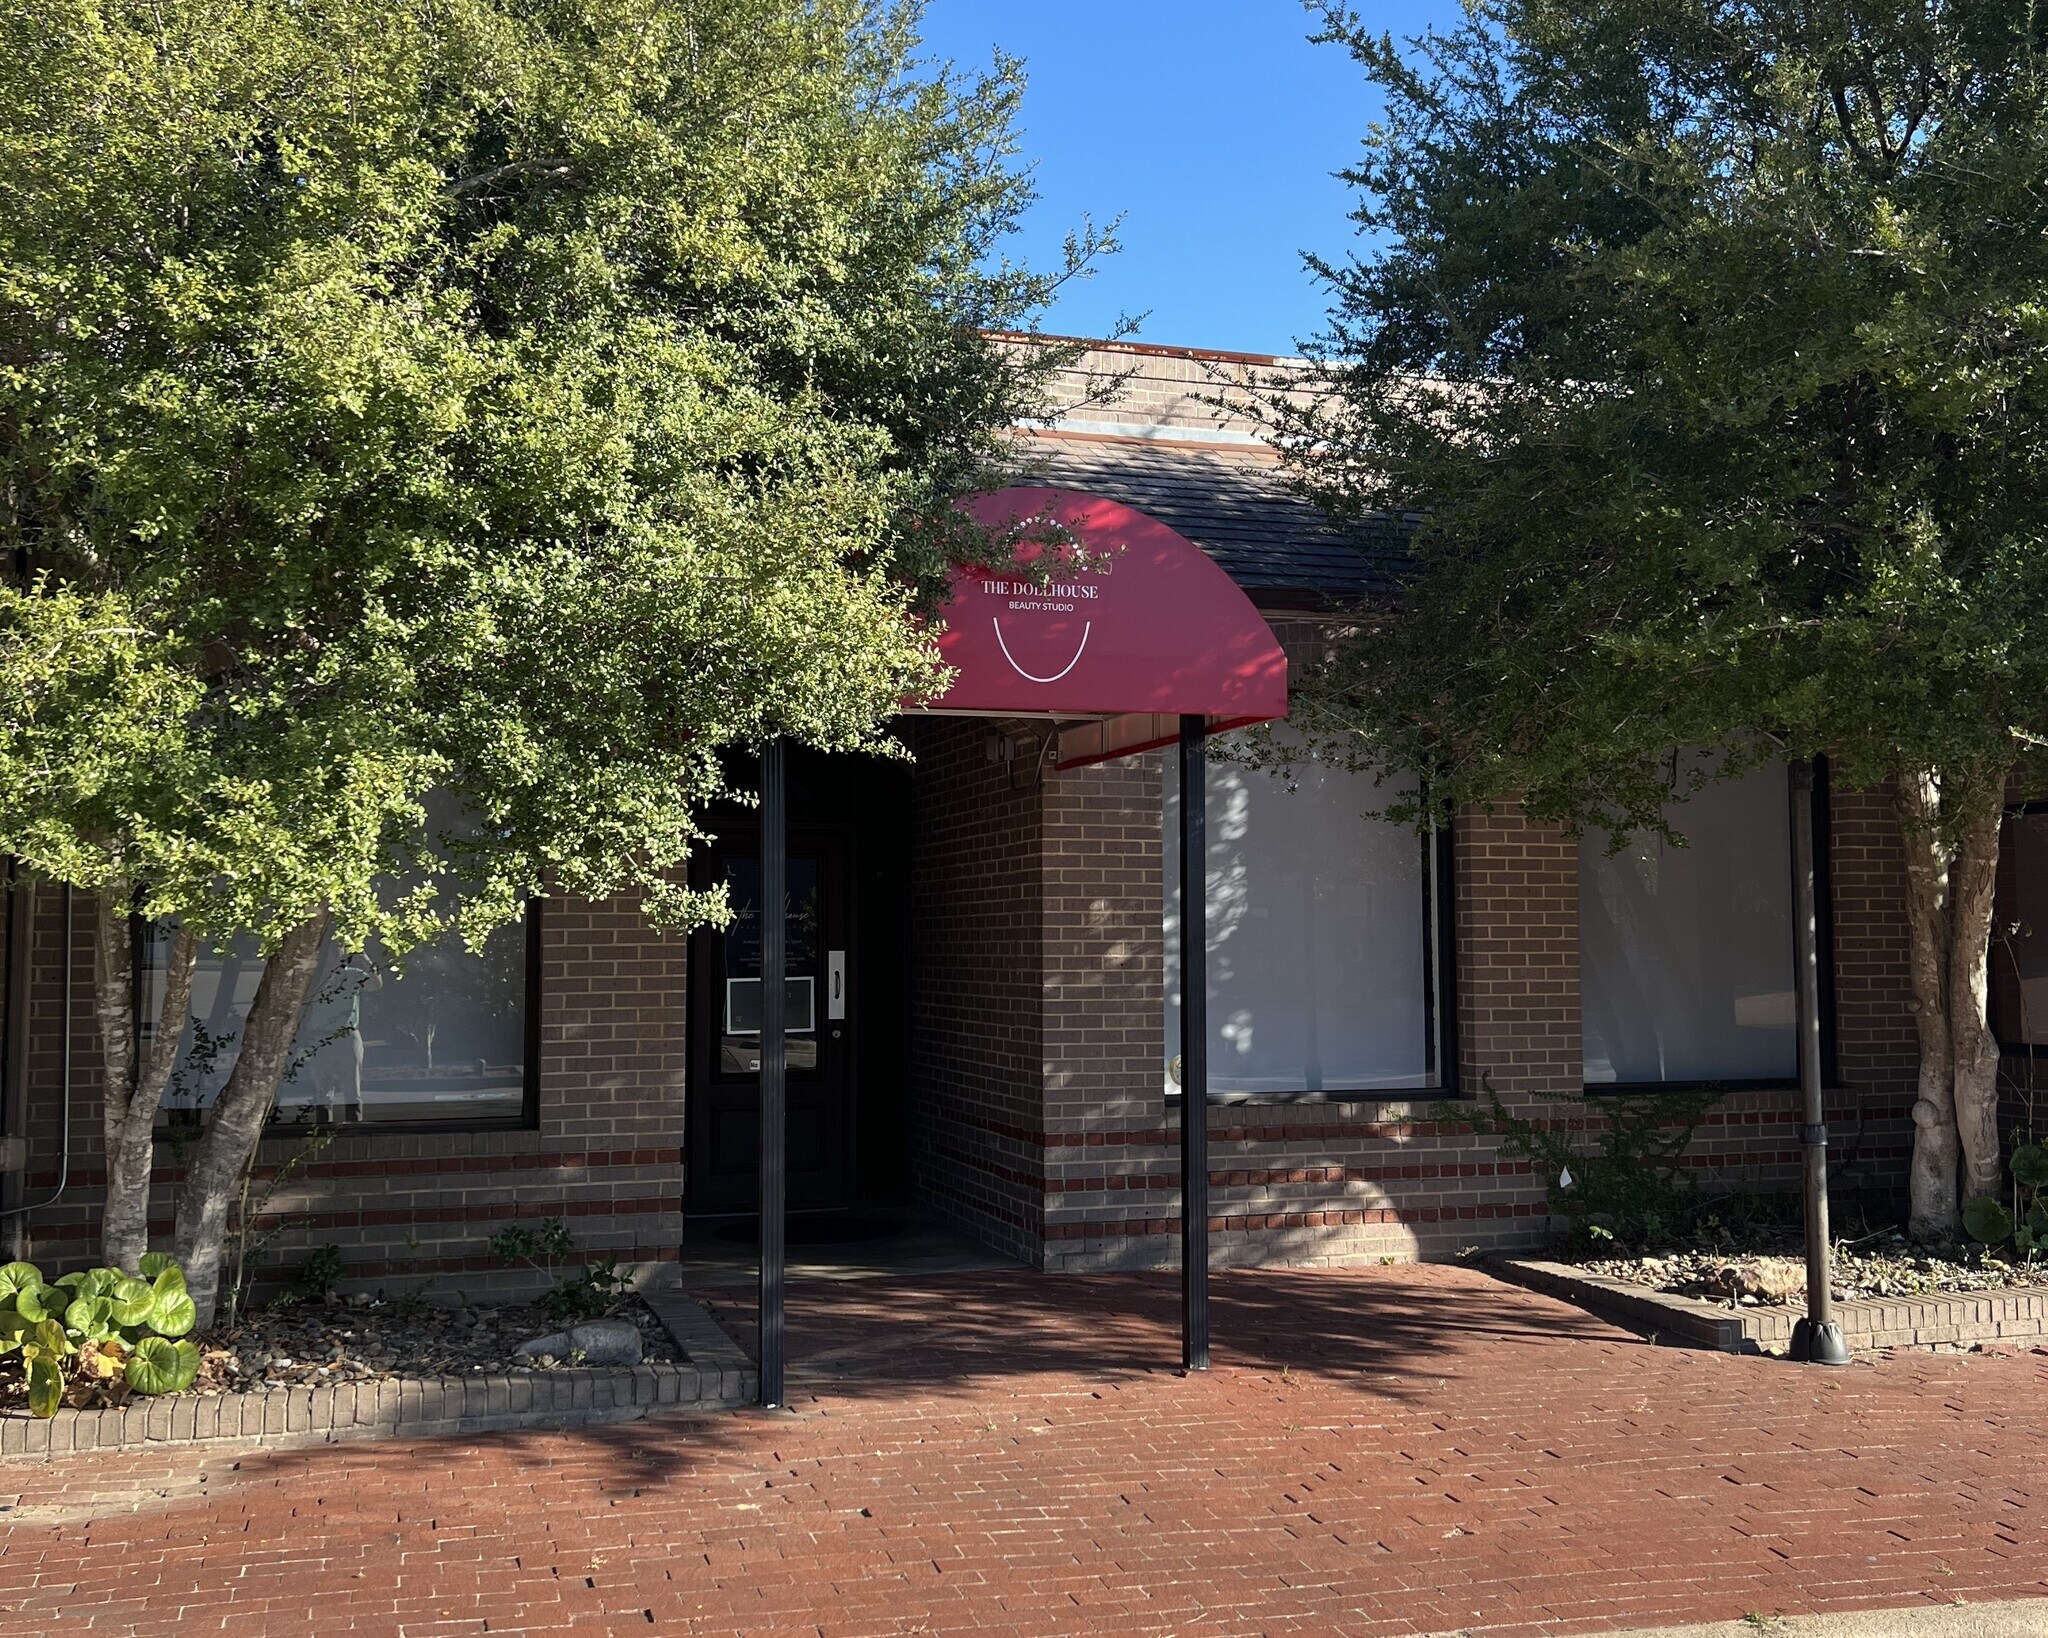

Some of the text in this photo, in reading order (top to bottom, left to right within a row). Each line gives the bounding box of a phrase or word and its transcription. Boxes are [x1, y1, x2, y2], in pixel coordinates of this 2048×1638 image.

[981, 580, 1099, 599] THE DOLLHOUSE
[1009, 601, 1074, 612] BEAUTY STUDIO
